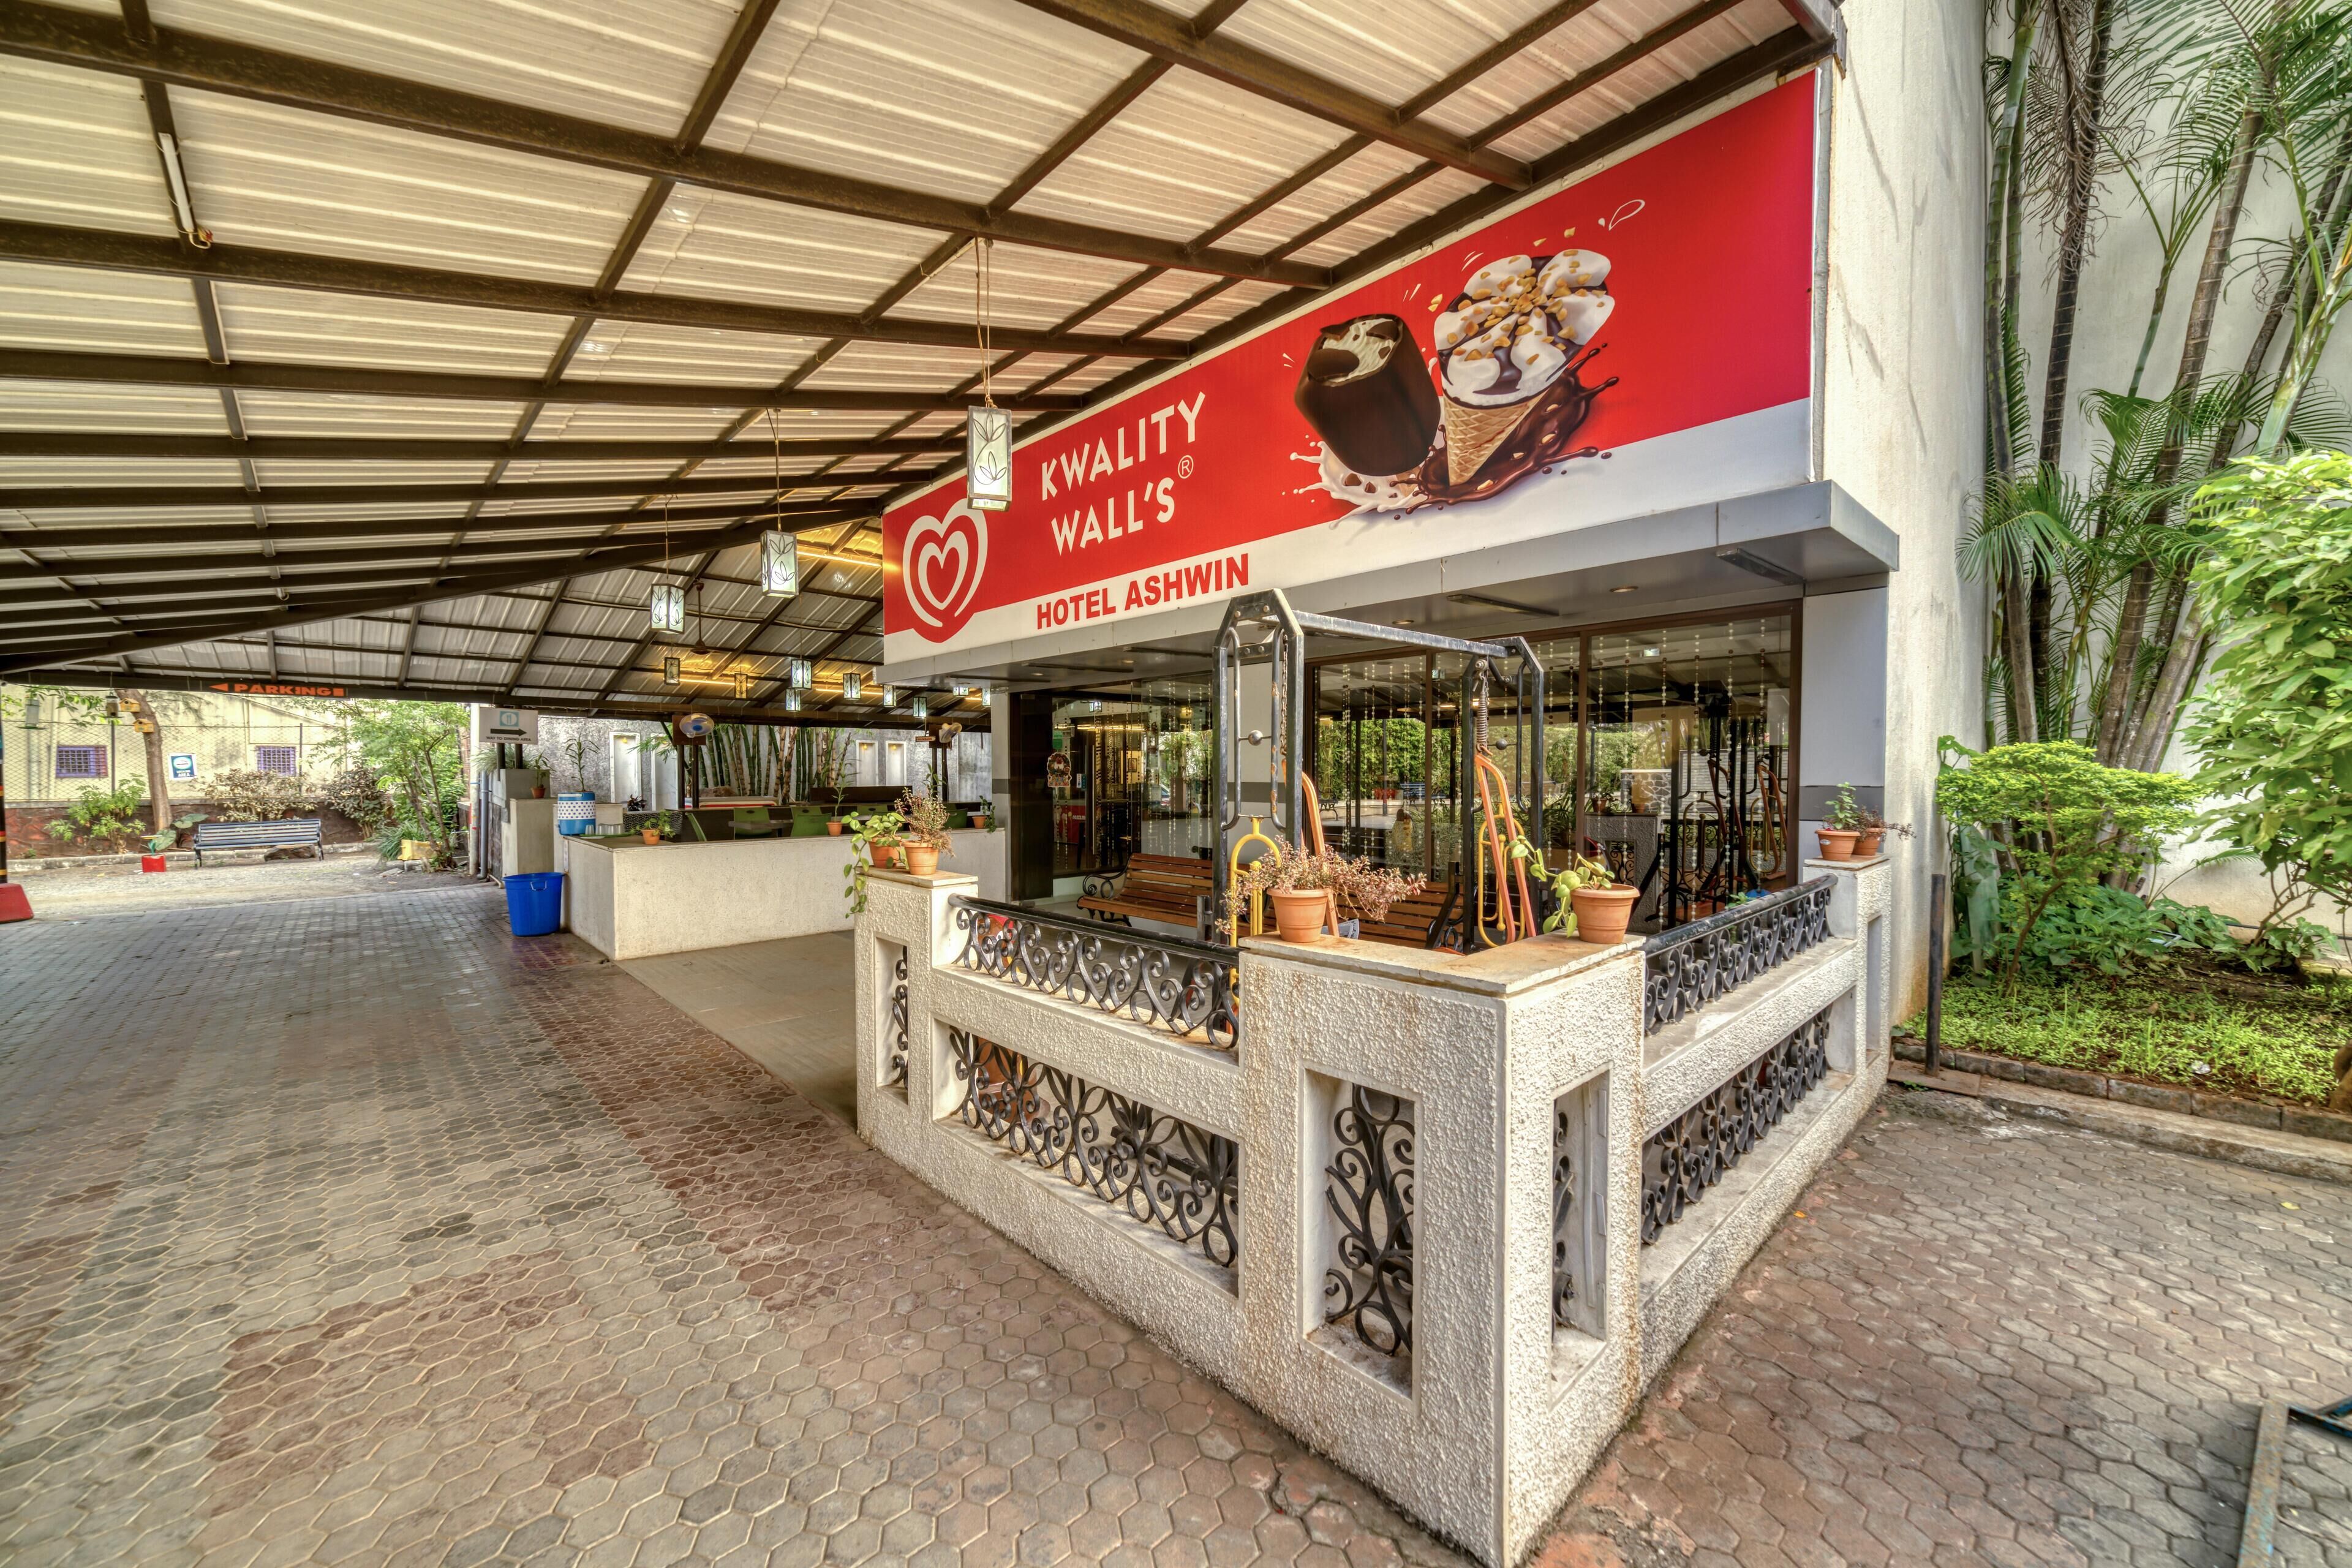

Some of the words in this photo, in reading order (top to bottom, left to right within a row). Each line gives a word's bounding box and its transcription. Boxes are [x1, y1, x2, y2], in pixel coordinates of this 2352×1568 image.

[1042, 391, 1205, 501] KWALITY
[1051, 477, 1175, 556] WALL'S
[1037, 588, 1116, 630] HOTEL
[1125, 553, 1249, 611] ASHWIN
[234, 684, 331, 696] PARKING
